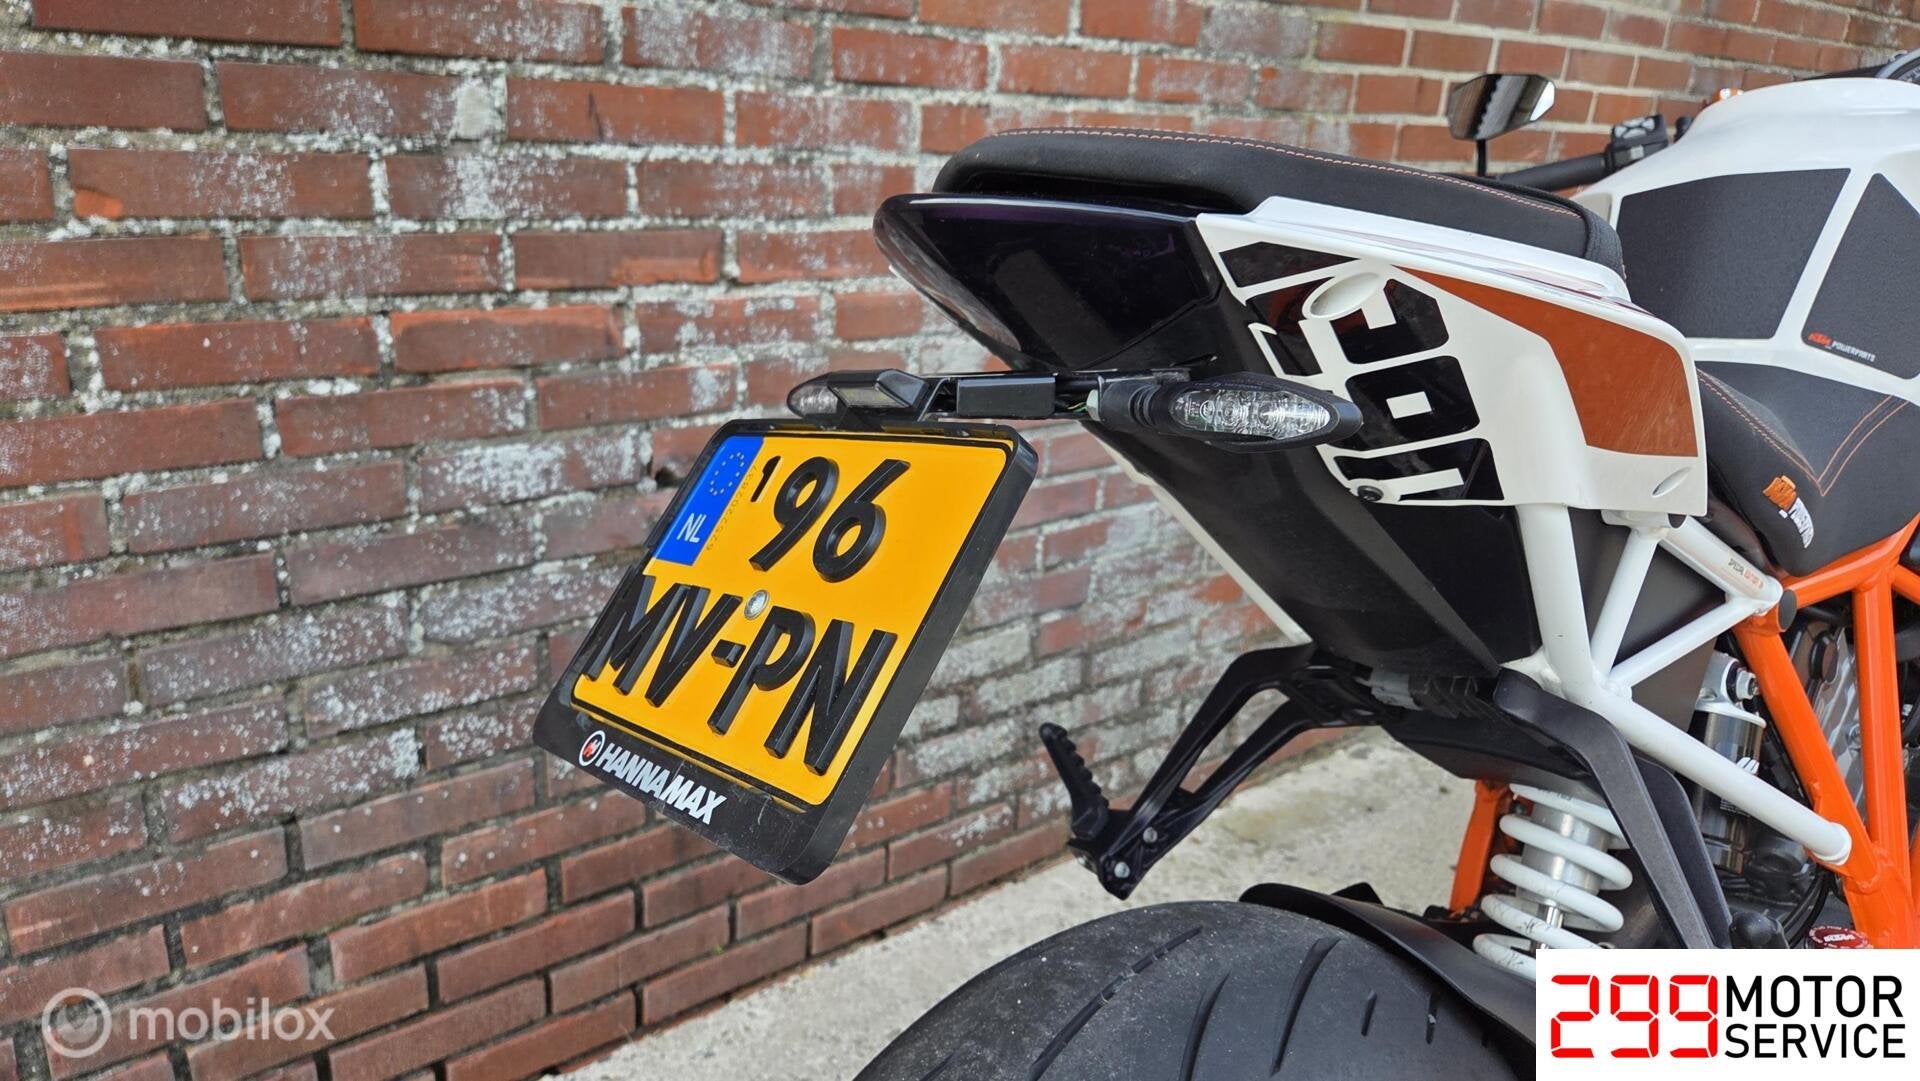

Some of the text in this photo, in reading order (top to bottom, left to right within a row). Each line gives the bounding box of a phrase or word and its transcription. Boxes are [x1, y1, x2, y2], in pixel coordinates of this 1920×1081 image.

[676, 512, 708, 544] NL
[581, 568, 898, 777] MV-PN
[595, 742, 728, 825] HANNAMAX
